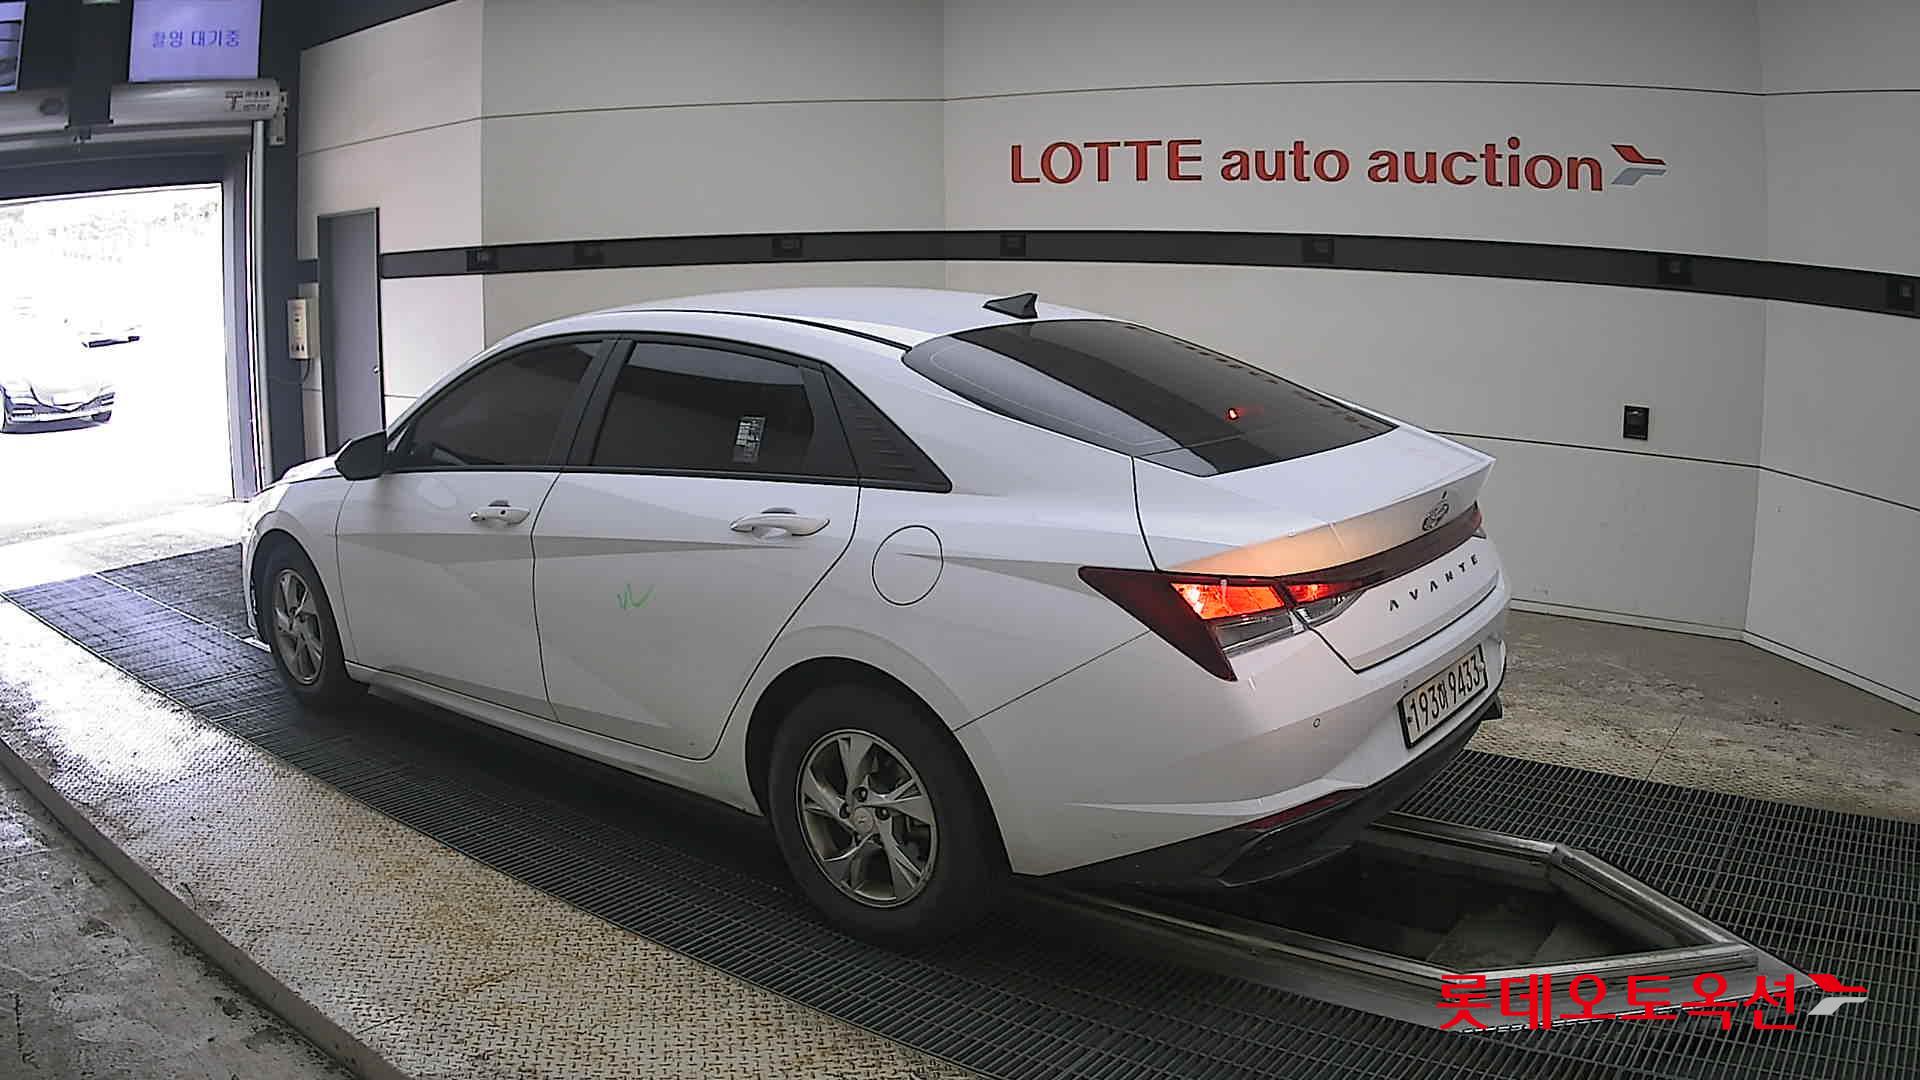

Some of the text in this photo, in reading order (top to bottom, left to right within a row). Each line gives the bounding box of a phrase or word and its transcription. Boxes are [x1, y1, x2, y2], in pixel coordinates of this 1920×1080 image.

[192, 30, 240, 49] 대기중
[1011, 136, 1603, 191] LOTTE auto auction
[1389, 554, 1479, 612] AVANTE
